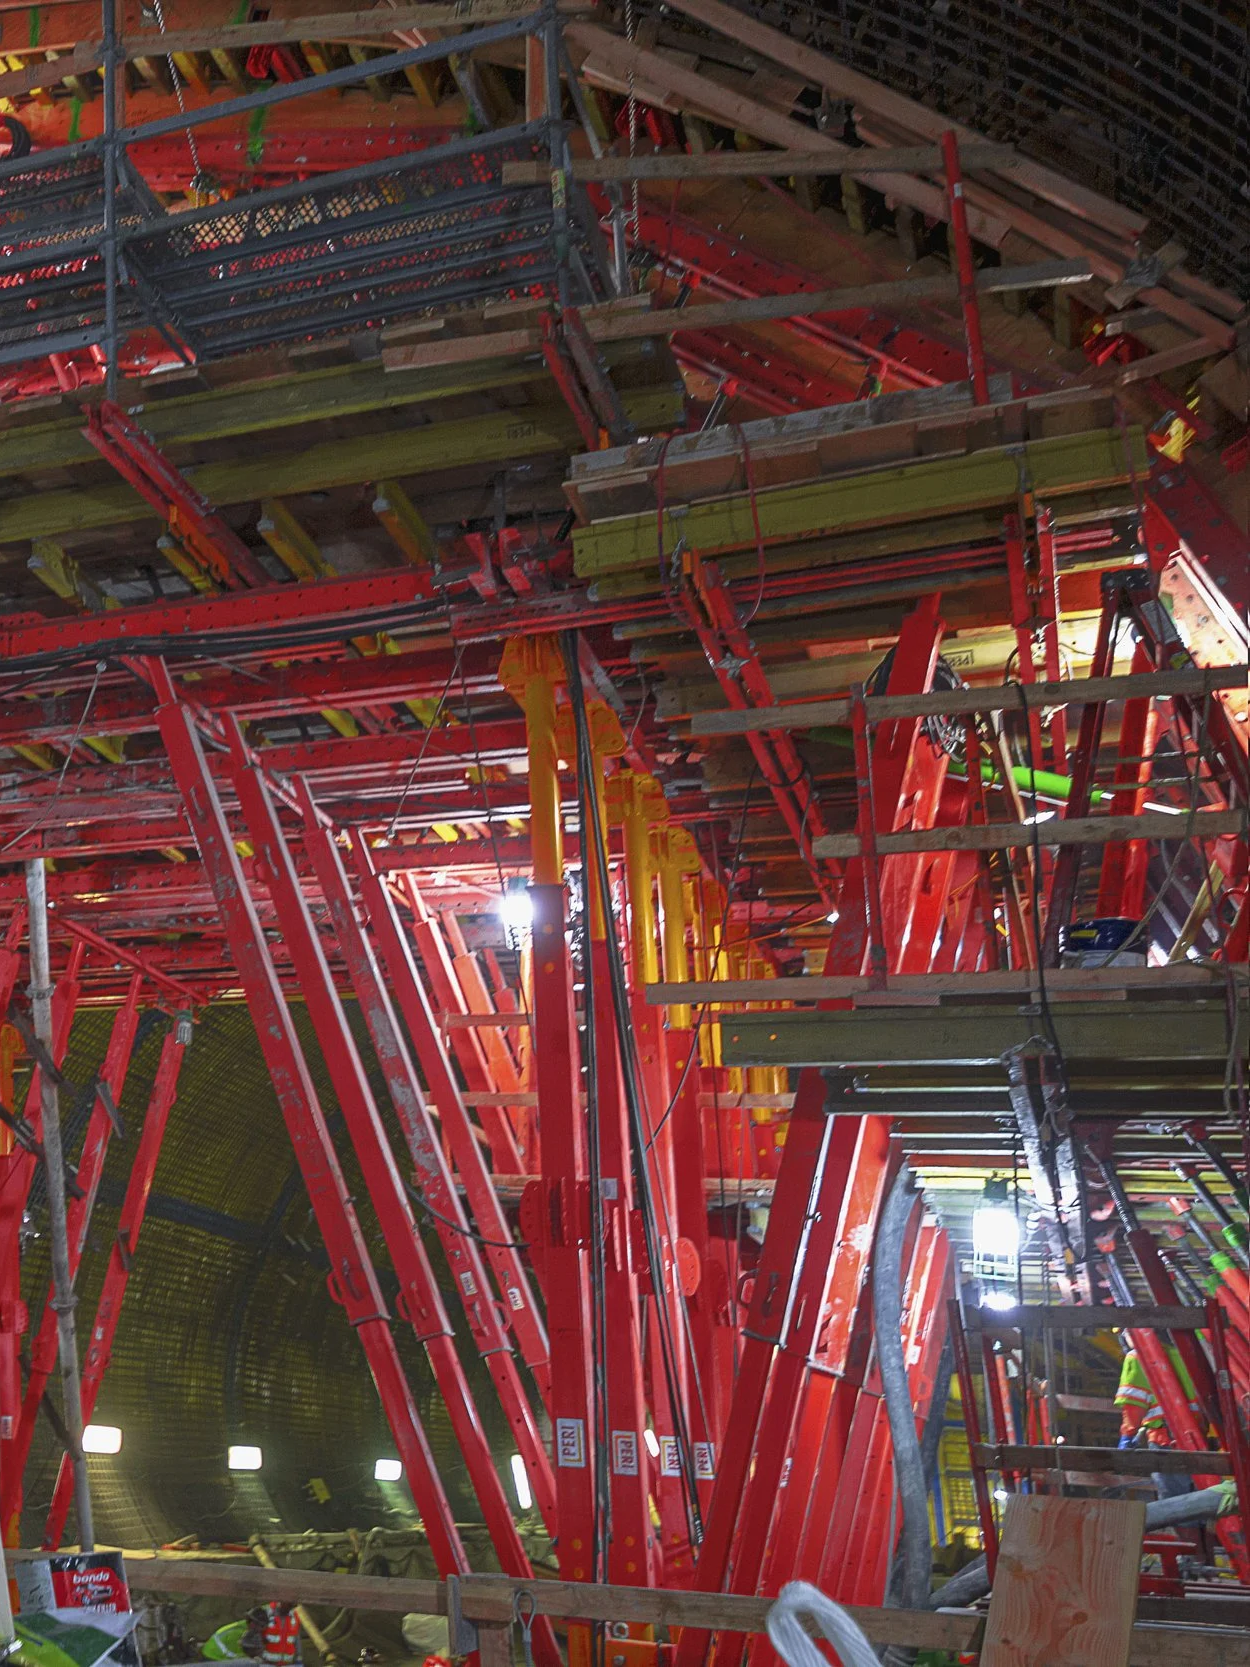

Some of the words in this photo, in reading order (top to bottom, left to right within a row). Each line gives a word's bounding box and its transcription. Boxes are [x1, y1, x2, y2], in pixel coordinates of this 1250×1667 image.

[561, 1426, 575, 1457] PERI
[621, 1440, 635, 1469] PERI
[696, 1448, 709, 1471] PERI
